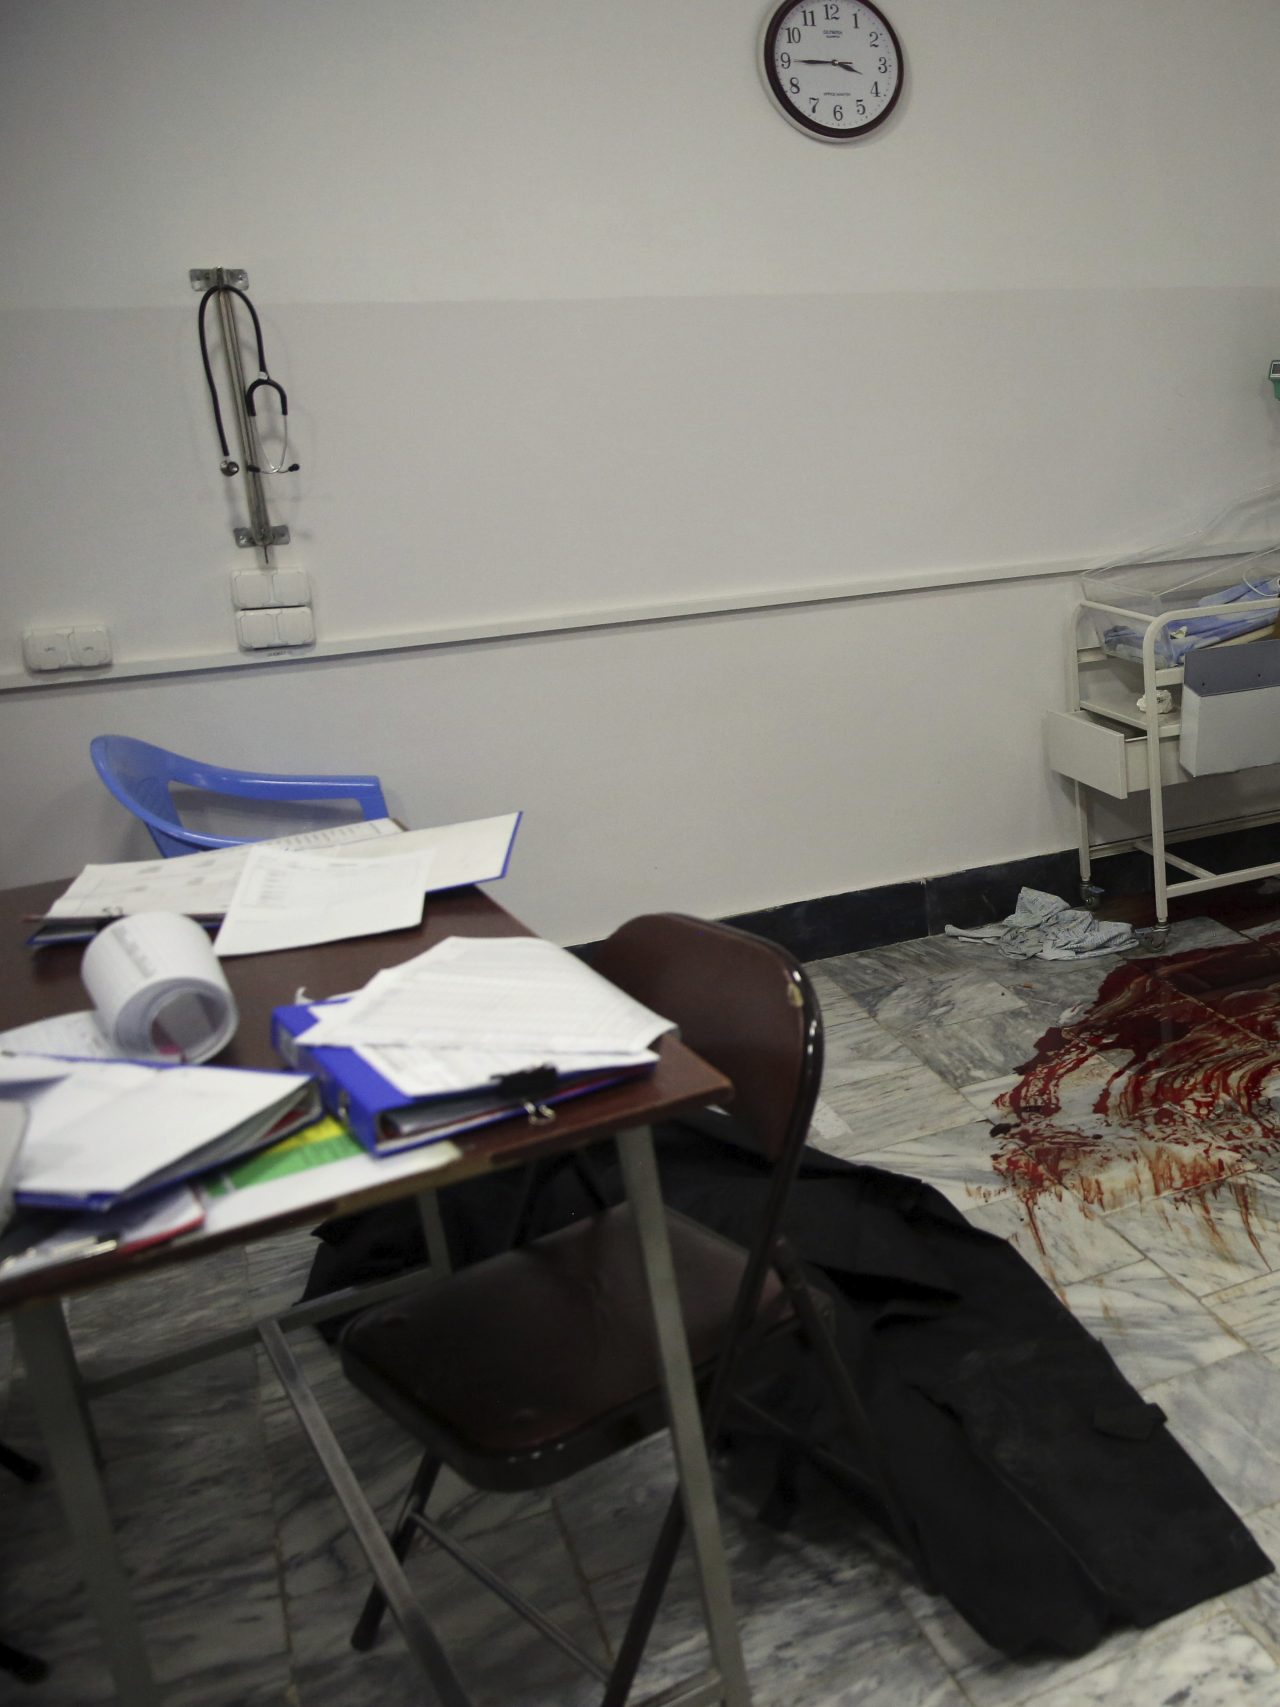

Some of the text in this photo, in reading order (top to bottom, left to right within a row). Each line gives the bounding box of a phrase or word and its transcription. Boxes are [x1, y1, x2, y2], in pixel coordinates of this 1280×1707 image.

[801, 10, 816, 26] 11
[824, 3, 840, 20] 12
[852, 13, 860, 29] 1
[785, 27, 801, 44] 10
[869, 31, 880, 48] 2
[780, 52, 791, 69] 9
[878, 56, 888, 74] 3
[789, 77, 800, 94] 8
[870, 81, 881, 97] 4
[808, 97, 819, 114] 7
[833, 104, 844, 121] 6
[856, 99, 866, 115] 5
